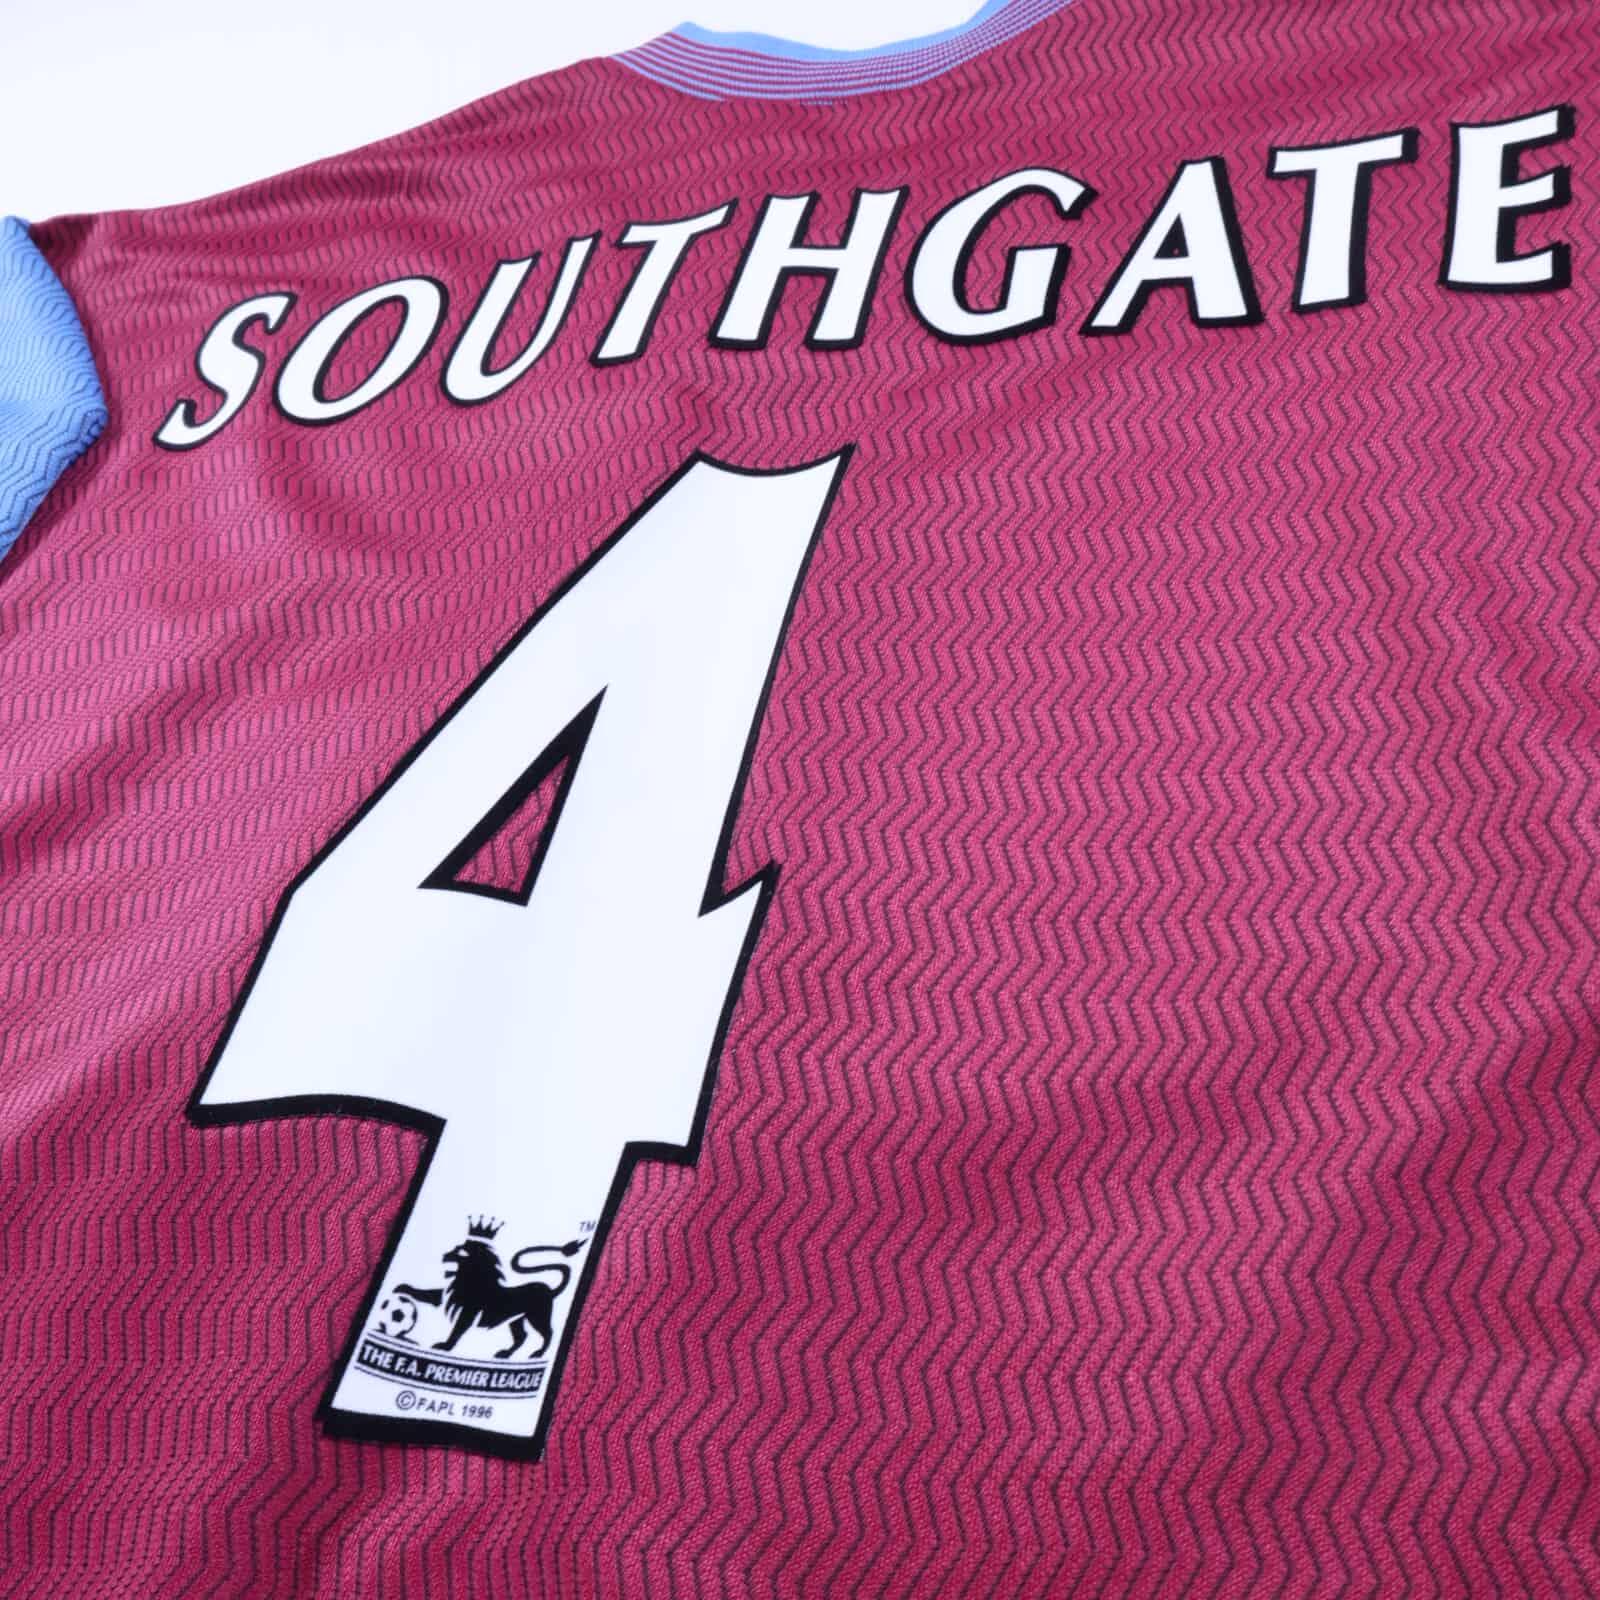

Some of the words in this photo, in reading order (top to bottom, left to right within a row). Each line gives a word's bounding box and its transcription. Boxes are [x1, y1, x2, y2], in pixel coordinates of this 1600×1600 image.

[152, 105, 1577, 450] SOUTHGATE
[187, 443, 855, 1462] 4
[362, 1344, 394, 1369] THE
[394, 1358, 422, 1377] F.A.
[424, 1363, 489, 1388] PREMIER
[490, 1371, 543, 1390] LEAGUE
[461, 1404, 494, 1419] 1996
